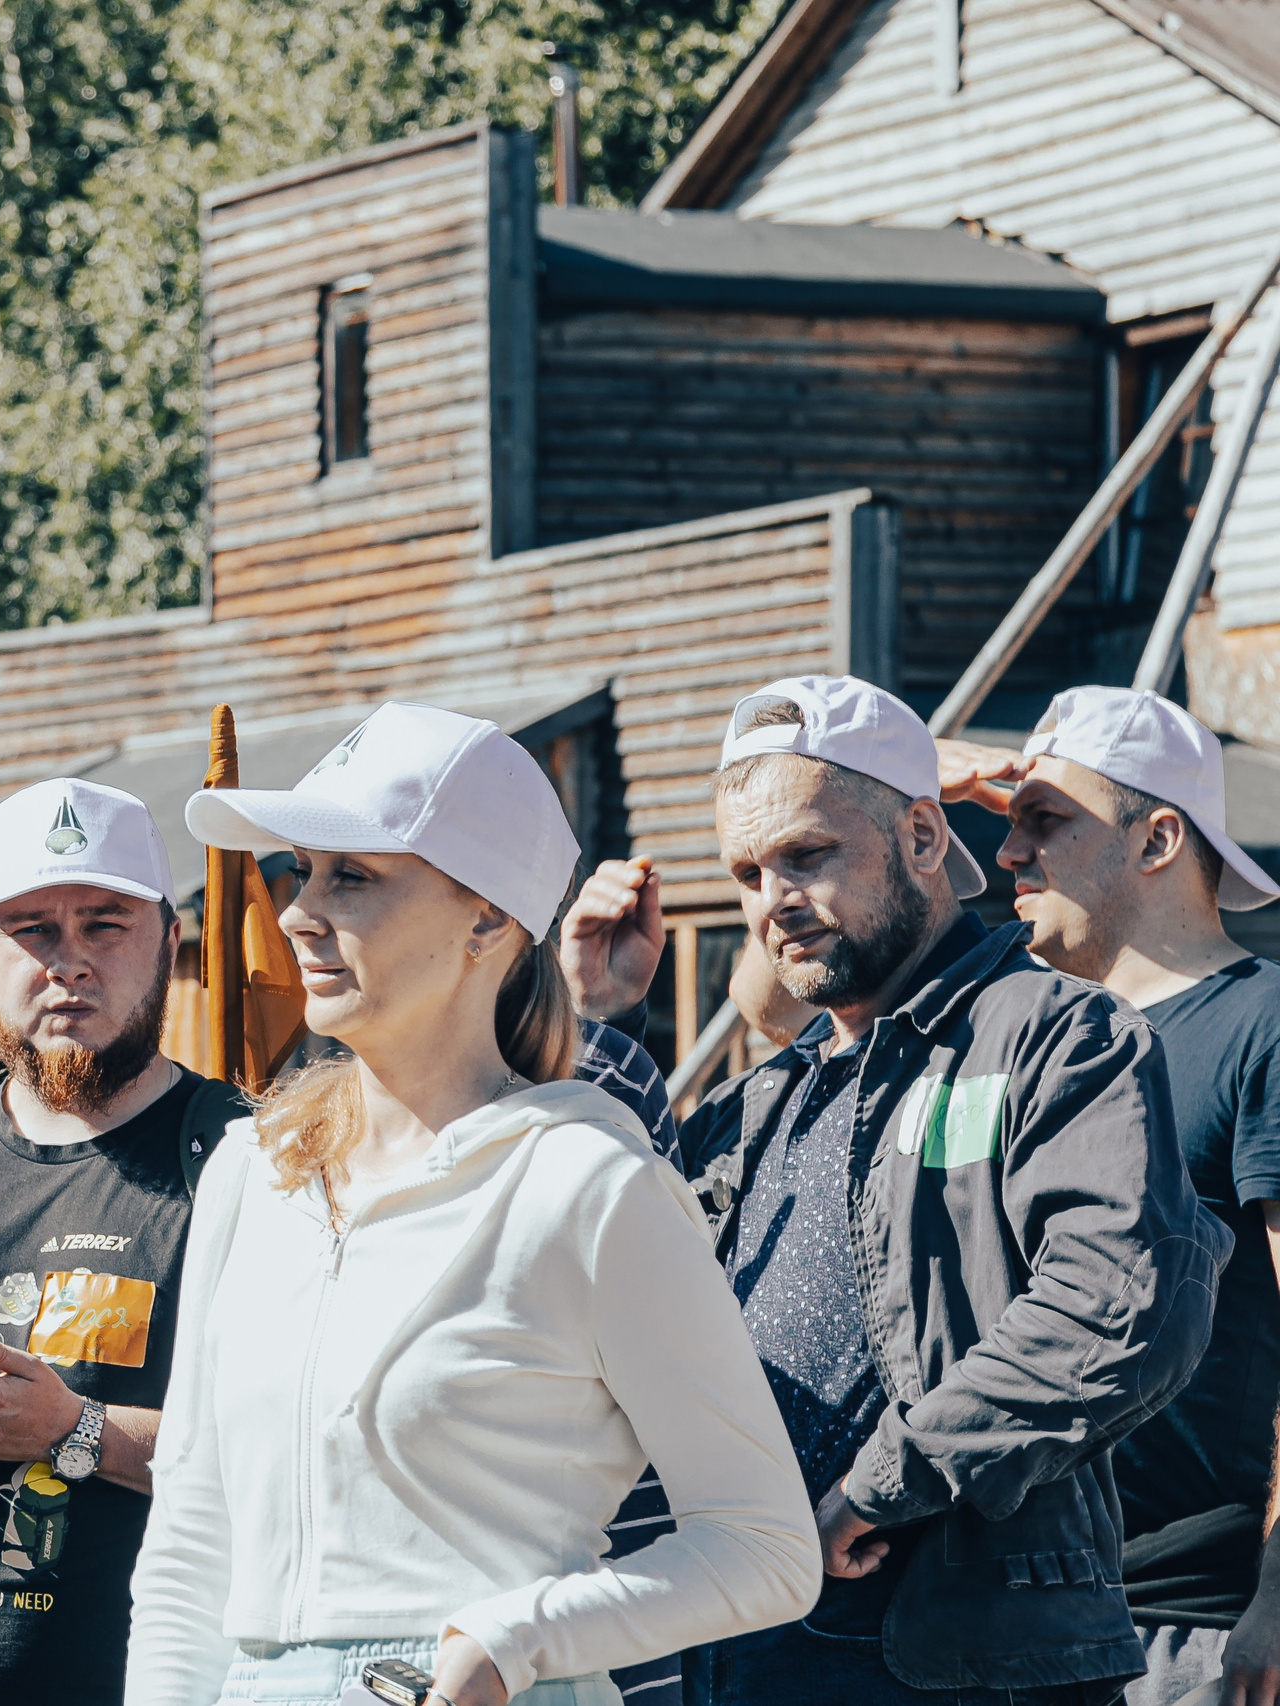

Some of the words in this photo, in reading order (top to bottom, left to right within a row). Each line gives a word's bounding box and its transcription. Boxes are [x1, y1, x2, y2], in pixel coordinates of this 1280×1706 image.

[60, 1233, 132, 1252] TERREX
[53, 1286, 132, 1329] Вася
[43, 1529, 54, 1560] TERREX
[13, 1592, 54, 1612] NEED
